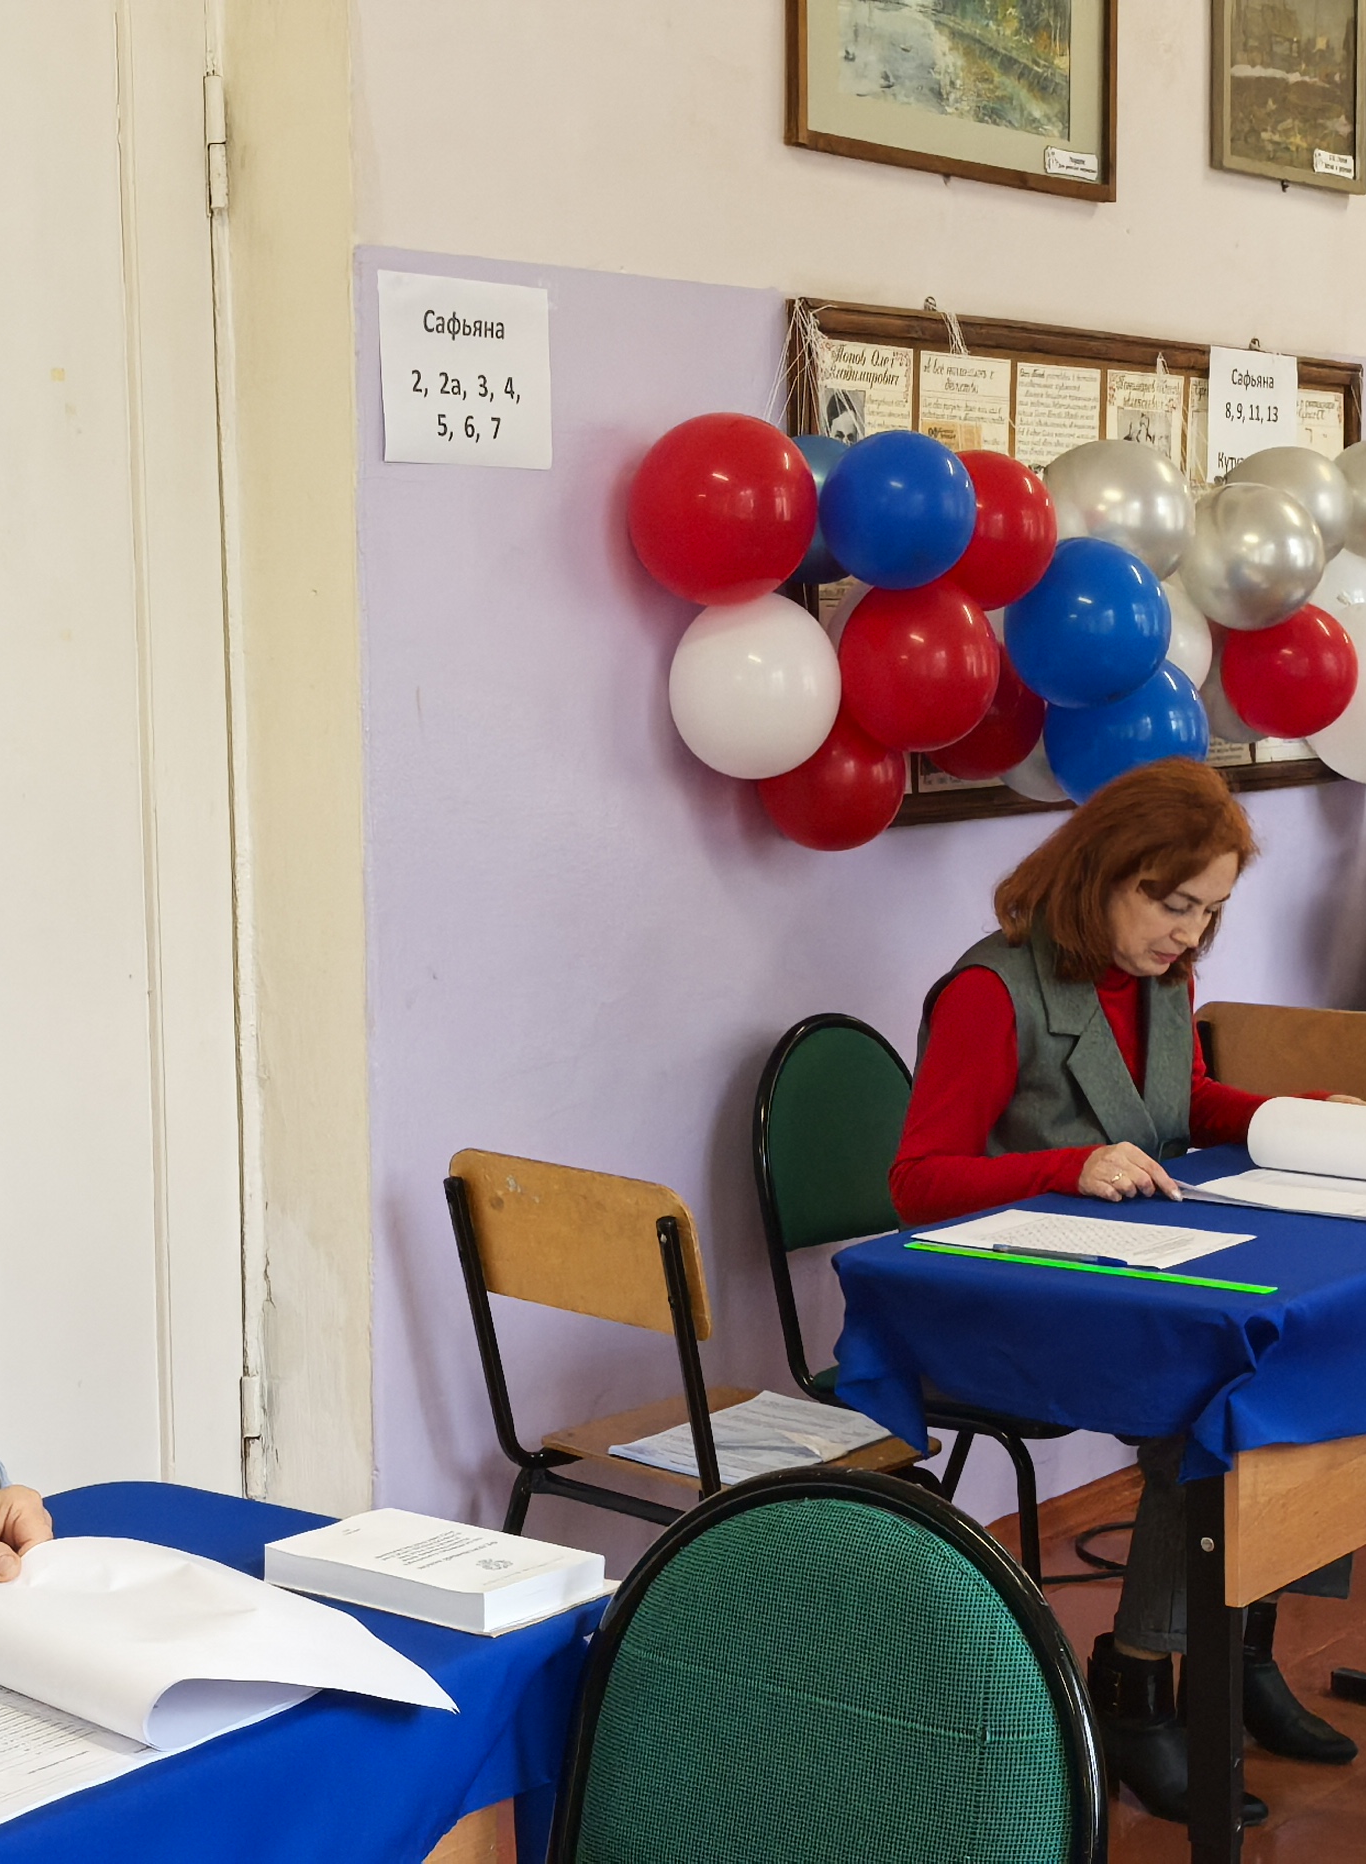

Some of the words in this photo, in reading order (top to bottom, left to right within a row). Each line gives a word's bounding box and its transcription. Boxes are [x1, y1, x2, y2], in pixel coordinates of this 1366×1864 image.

[423, 309, 505, 341] Сафьяна
[411, 369, 429, 398] 2,
[438, 371, 467, 401] 2а,
[477, 374, 494, 403] 3,
[503, 376, 521, 404] 4,
[1231, 368, 1275, 390] Сафьяна
[437, 413, 454, 442] 5,
[464, 415, 480, 443] 6,
[490, 416, 501, 439] 7
[1225, 401, 1235, 422] 8,
[1236, 403, 1246, 423] 9,
[1248, 404, 1264, 425] 11,
[1267, 406, 1279, 422] 13
